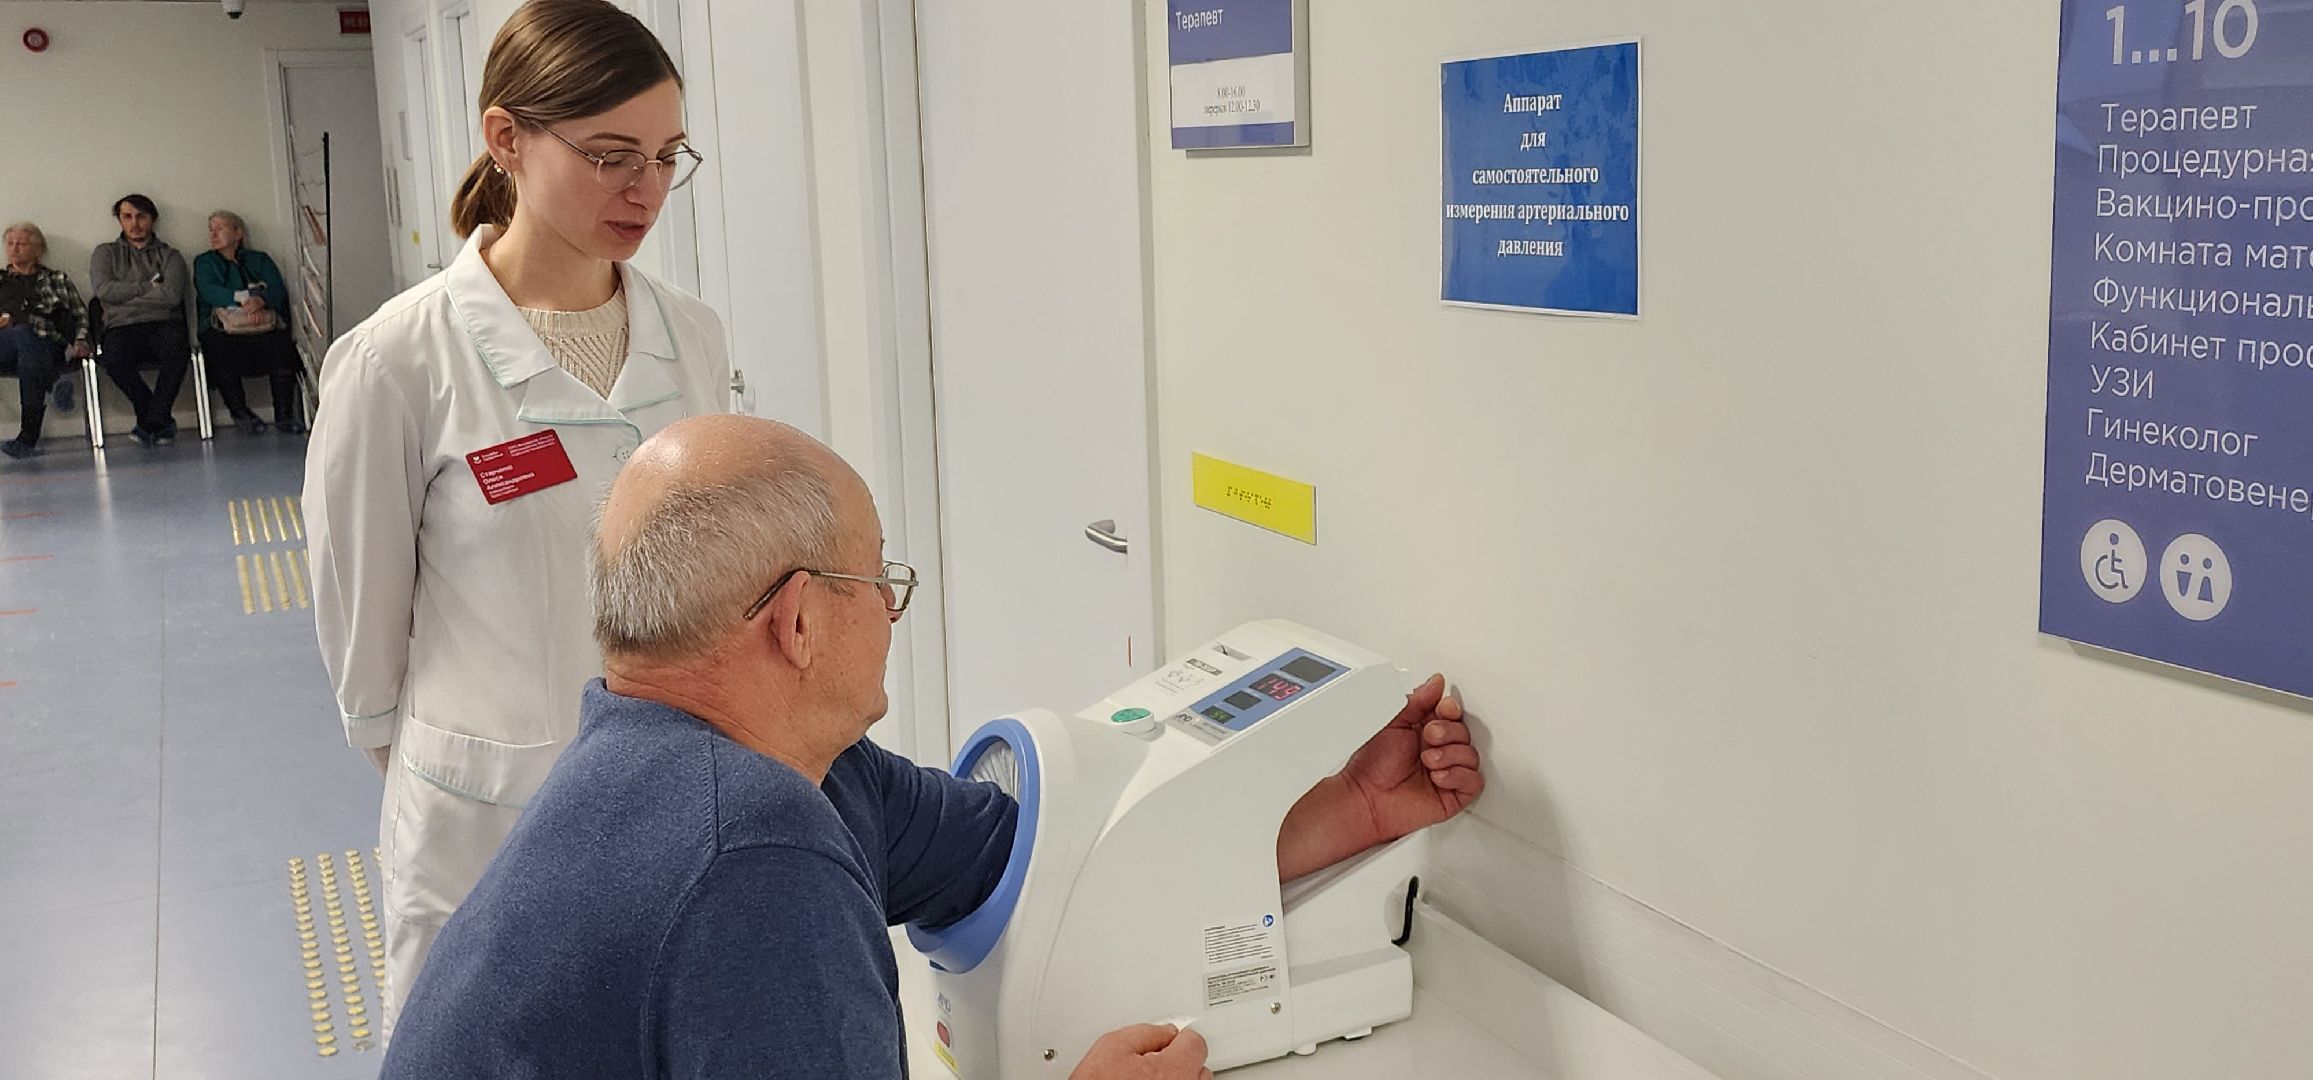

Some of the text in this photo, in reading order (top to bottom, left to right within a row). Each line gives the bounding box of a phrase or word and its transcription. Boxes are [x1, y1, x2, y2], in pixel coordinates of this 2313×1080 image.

[1175, 9, 1224, 32] Терапевт
[1503, 93, 1563, 117] Аппарат
[2100, 103, 2258, 138] Терапевт
[1520, 131, 1547, 152] для
[1472, 167, 1599, 185] самостоятельного
[2098, 143, 2313, 180] Процедурна
[1446, 203, 1630, 225] измерения артериального
[1497, 239, 1564, 258] давления
[2094, 232, 2313, 270] Комната мат
[2090, 320, 2227, 361] Кабинет
[2089, 363, 2155, 400] УЗИ
[2086, 407, 2260, 458] Гинеколог
[2085, 451, 2313, 521] Дерматовене
